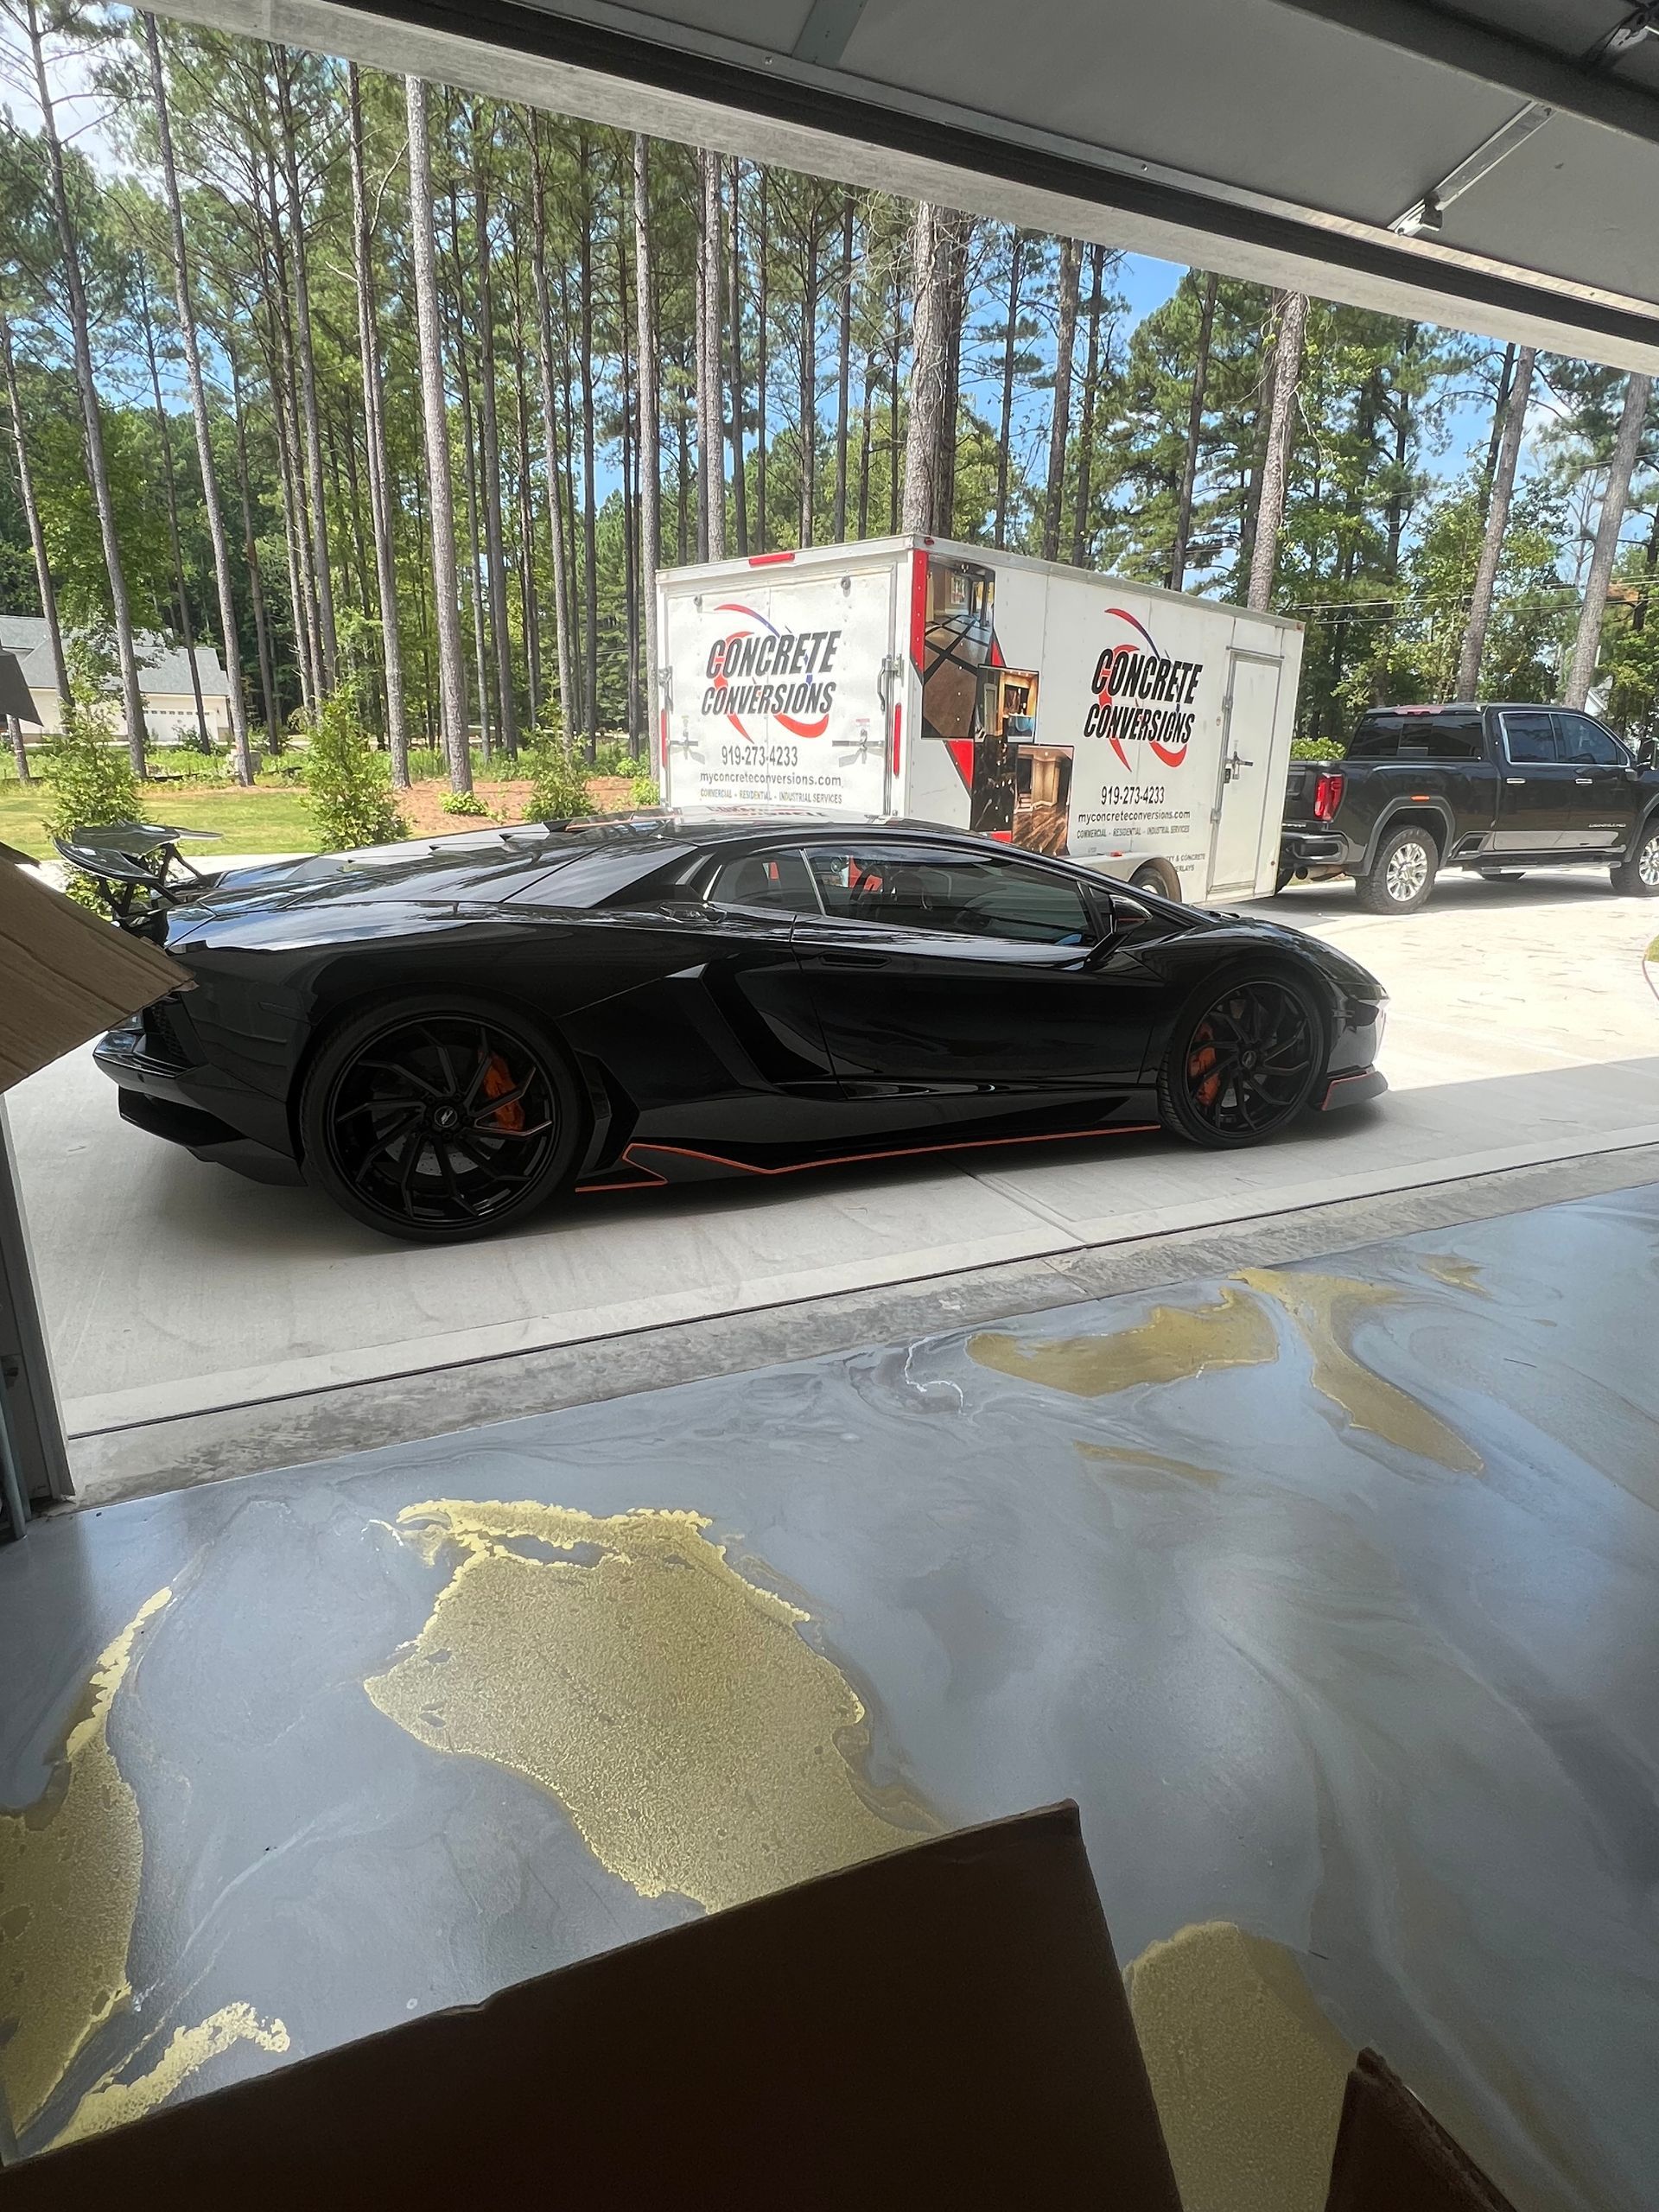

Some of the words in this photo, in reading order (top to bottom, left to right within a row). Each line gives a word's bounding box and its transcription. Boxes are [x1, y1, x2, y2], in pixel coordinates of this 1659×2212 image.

[705, 630, 842, 679] CONCRETE
[1090, 648, 1204, 704] CONCRETE
[701, 681, 837, 715] CONVERSIONS
[1083, 703, 1196, 744] CONVERSIONS
[721, 746, 798, 766] 919-273-4233
[700, 772, 842, 787] myconcreteconversions.com
[700, 788, 732, 798] COMMERCIAL
[739, 790, 772, 801] RESIDENTIAL
[779, 791, 811, 803] INDUSTRIAL
[813, 793, 842, 804] SERVICES
[1101, 785, 1165, 805] 919-273-4233
[1077, 810, 1191, 825] myconcreteconversions.com
[1077, 829, 1107, 839] COMMERCIAL
[1113, 827, 1141, 836] RESIDENTIAL
[1170, 824, 1190, 834] SERVICES
